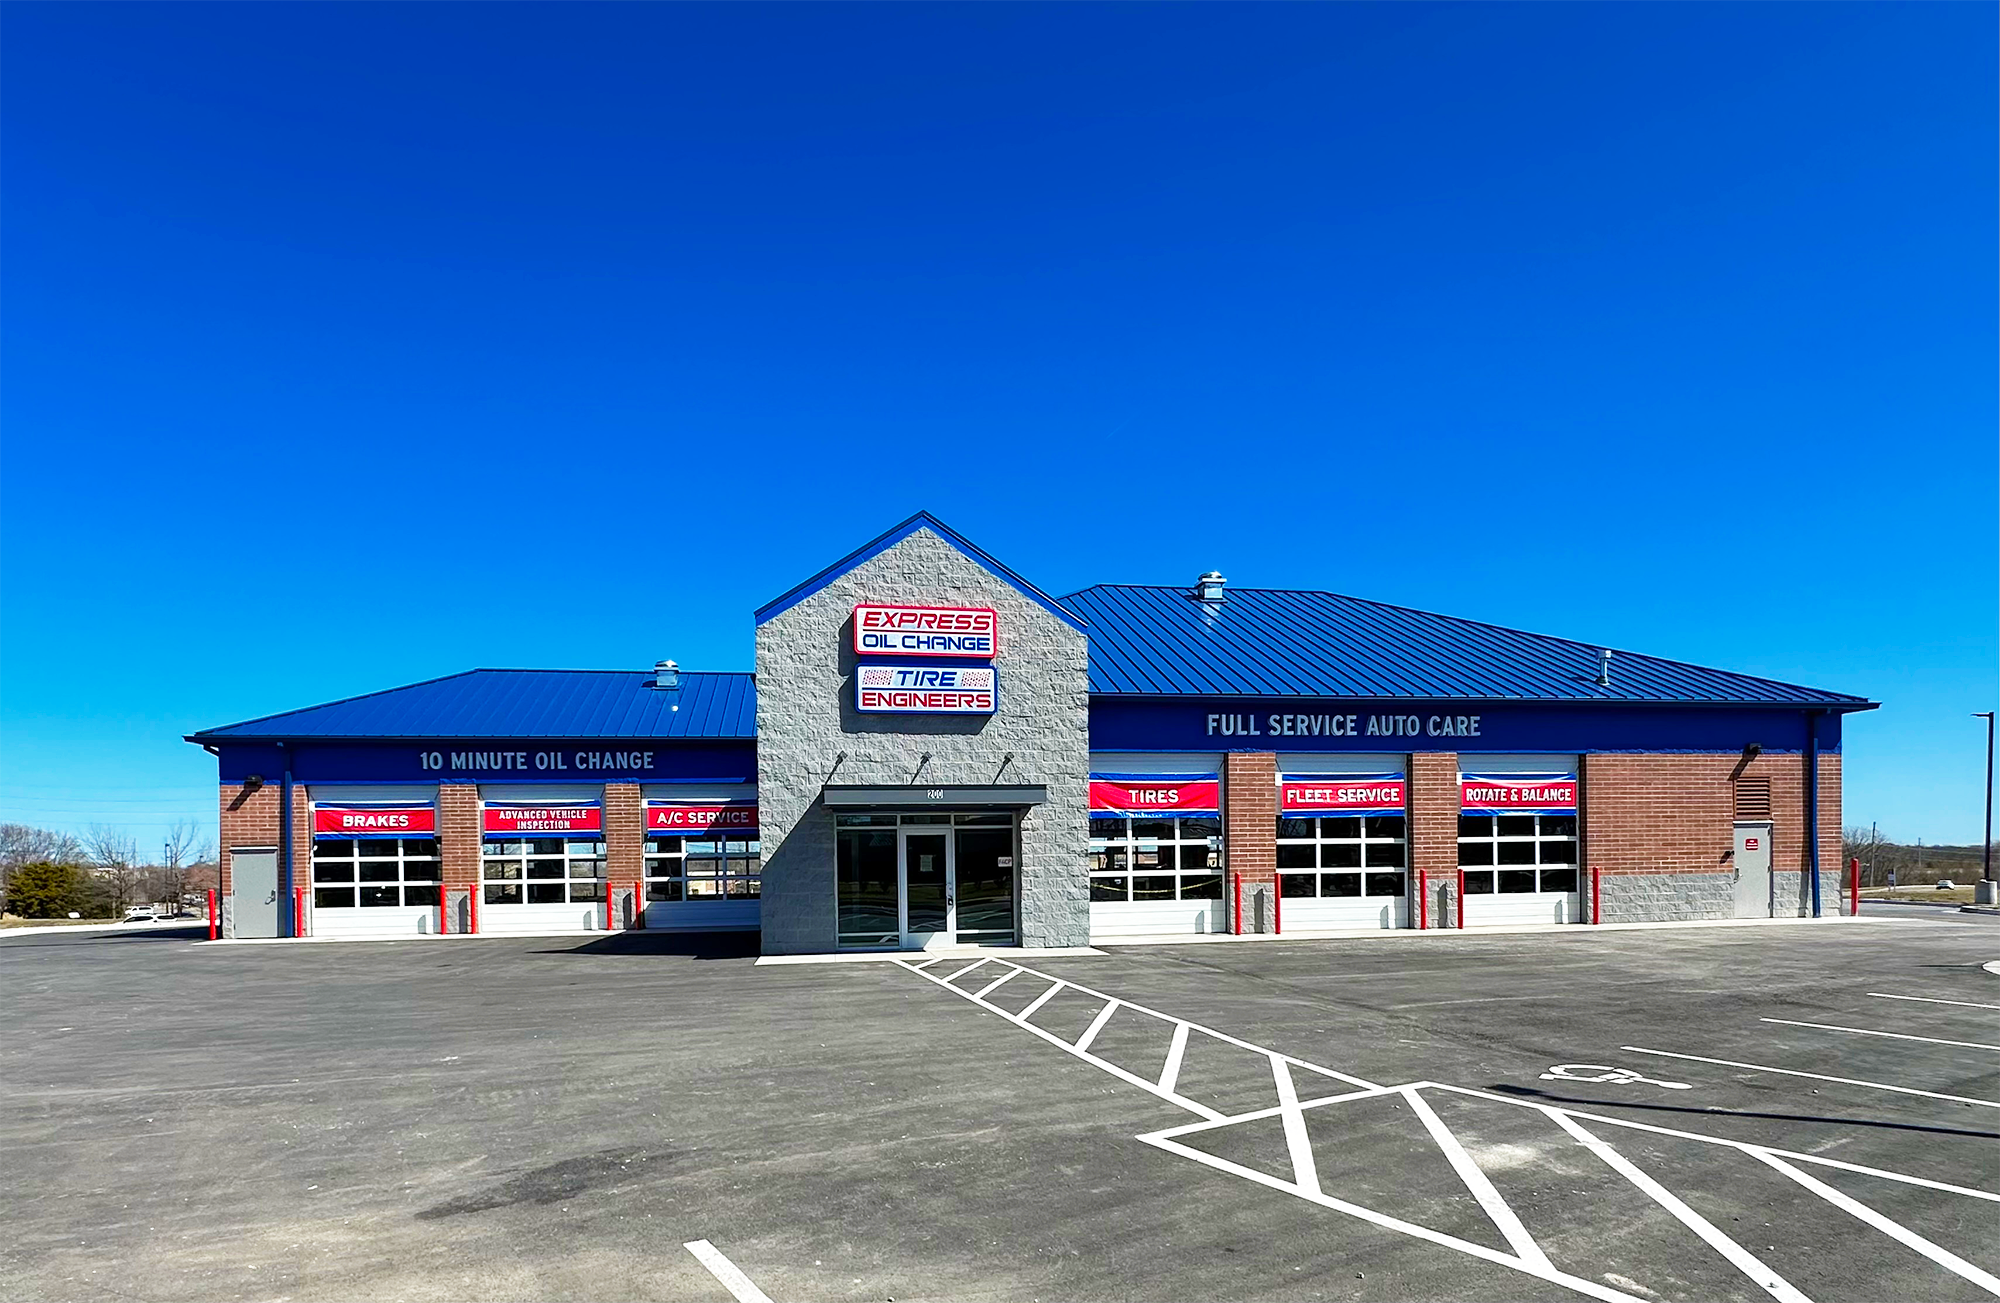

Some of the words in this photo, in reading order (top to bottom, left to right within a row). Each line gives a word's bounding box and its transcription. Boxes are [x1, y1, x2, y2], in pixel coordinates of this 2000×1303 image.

[863, 611, 991, 630] EXPRESS
[862, 634, 897, 648] OIL
[901, 635, 990, 651] CHANGE
[897, 670, 957, 687] TIRE
[862, 692, 991, 708] ENGINEERS
[1206, 714, 1261, 737] FULL
[1267, 714, 1358, 737] SERVICE
[1364, 715, 1421, 737] AUTO
[1426, 716, 1481, 737] CARE
[420, 752, 443, 770] 10
[451, 752, 528, 770] MINUTE
[535, 752, 567, 770] OIL
[575, 752, 654, 770] CHANGE
[1128, 789, 1179, 803] TIRES
[1287, 789, 1333, 803] FLEET
[1338, 788, 1400, 803] SERVICE
[1465, 788, 1508, 802] ROTATE
[1510, 788, 1519, 801] &
[1521, 788, 1572, 801] BALANCE
[342, 815, 409, 827] BRAKES
[499, 810, 547, 820] ADVANCED
[550, 810, 587, 819] VEHICLE
[656, 811, 683, 825] A/C
[687, 811, 749, 824] SERVICE
[517, 820, 570, 830] INSPECTION
